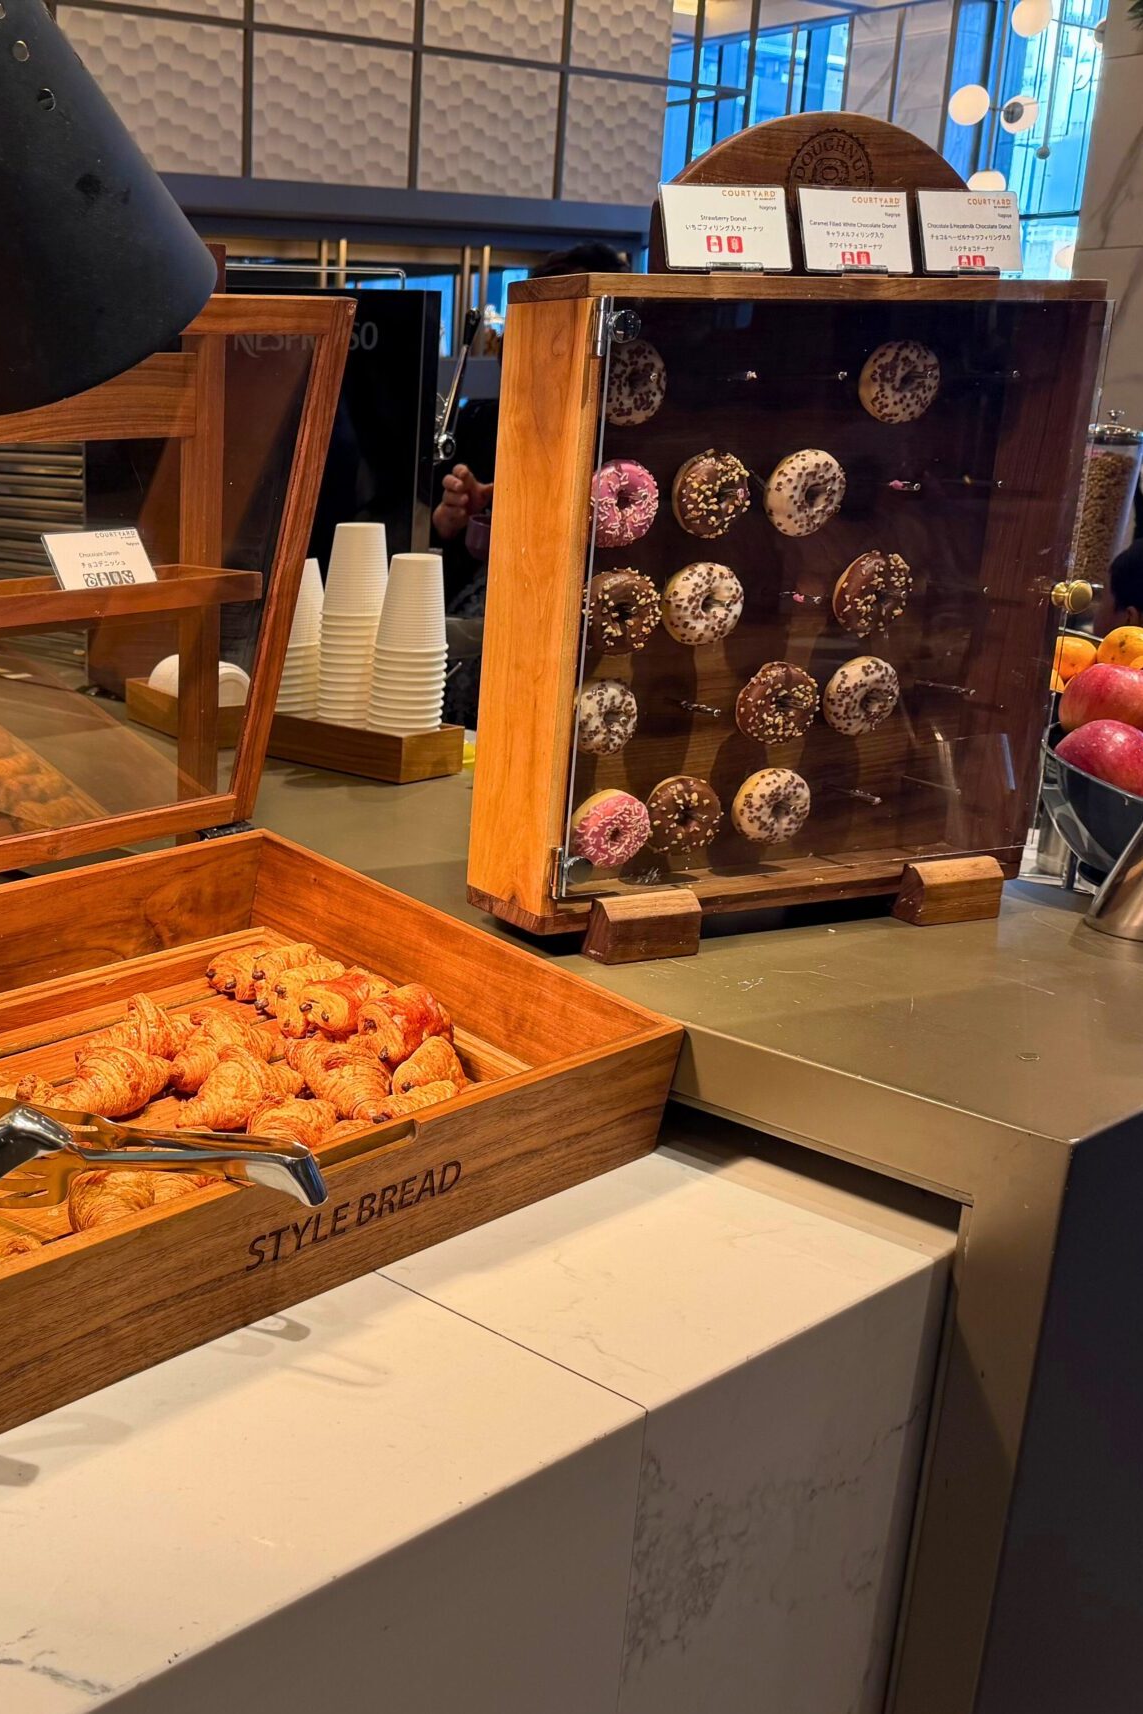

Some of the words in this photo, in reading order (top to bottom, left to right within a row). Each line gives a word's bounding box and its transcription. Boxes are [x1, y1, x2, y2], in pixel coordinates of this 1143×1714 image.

[795, 137, 866, 181] DOUGHNUT
[721, 189, 776, 197] COURTYARD
[851, 196, 900, 204] COURTYARD
[967, 198, 1012, 206] COURTYARD
[700, 214, 729, 222] Strawberry
[685, 224, 764, 232] いちごフィリング入りドーナツ
[856, 221, 881, 229] Chocolate
[826, 230, 885, 239] キャラメルフィリング入り
[95, 530, 136, 539] COURTYARD
[245, 1201, 350, 1272] STYLE
[356, 1160, 462, 1227] BREAD
